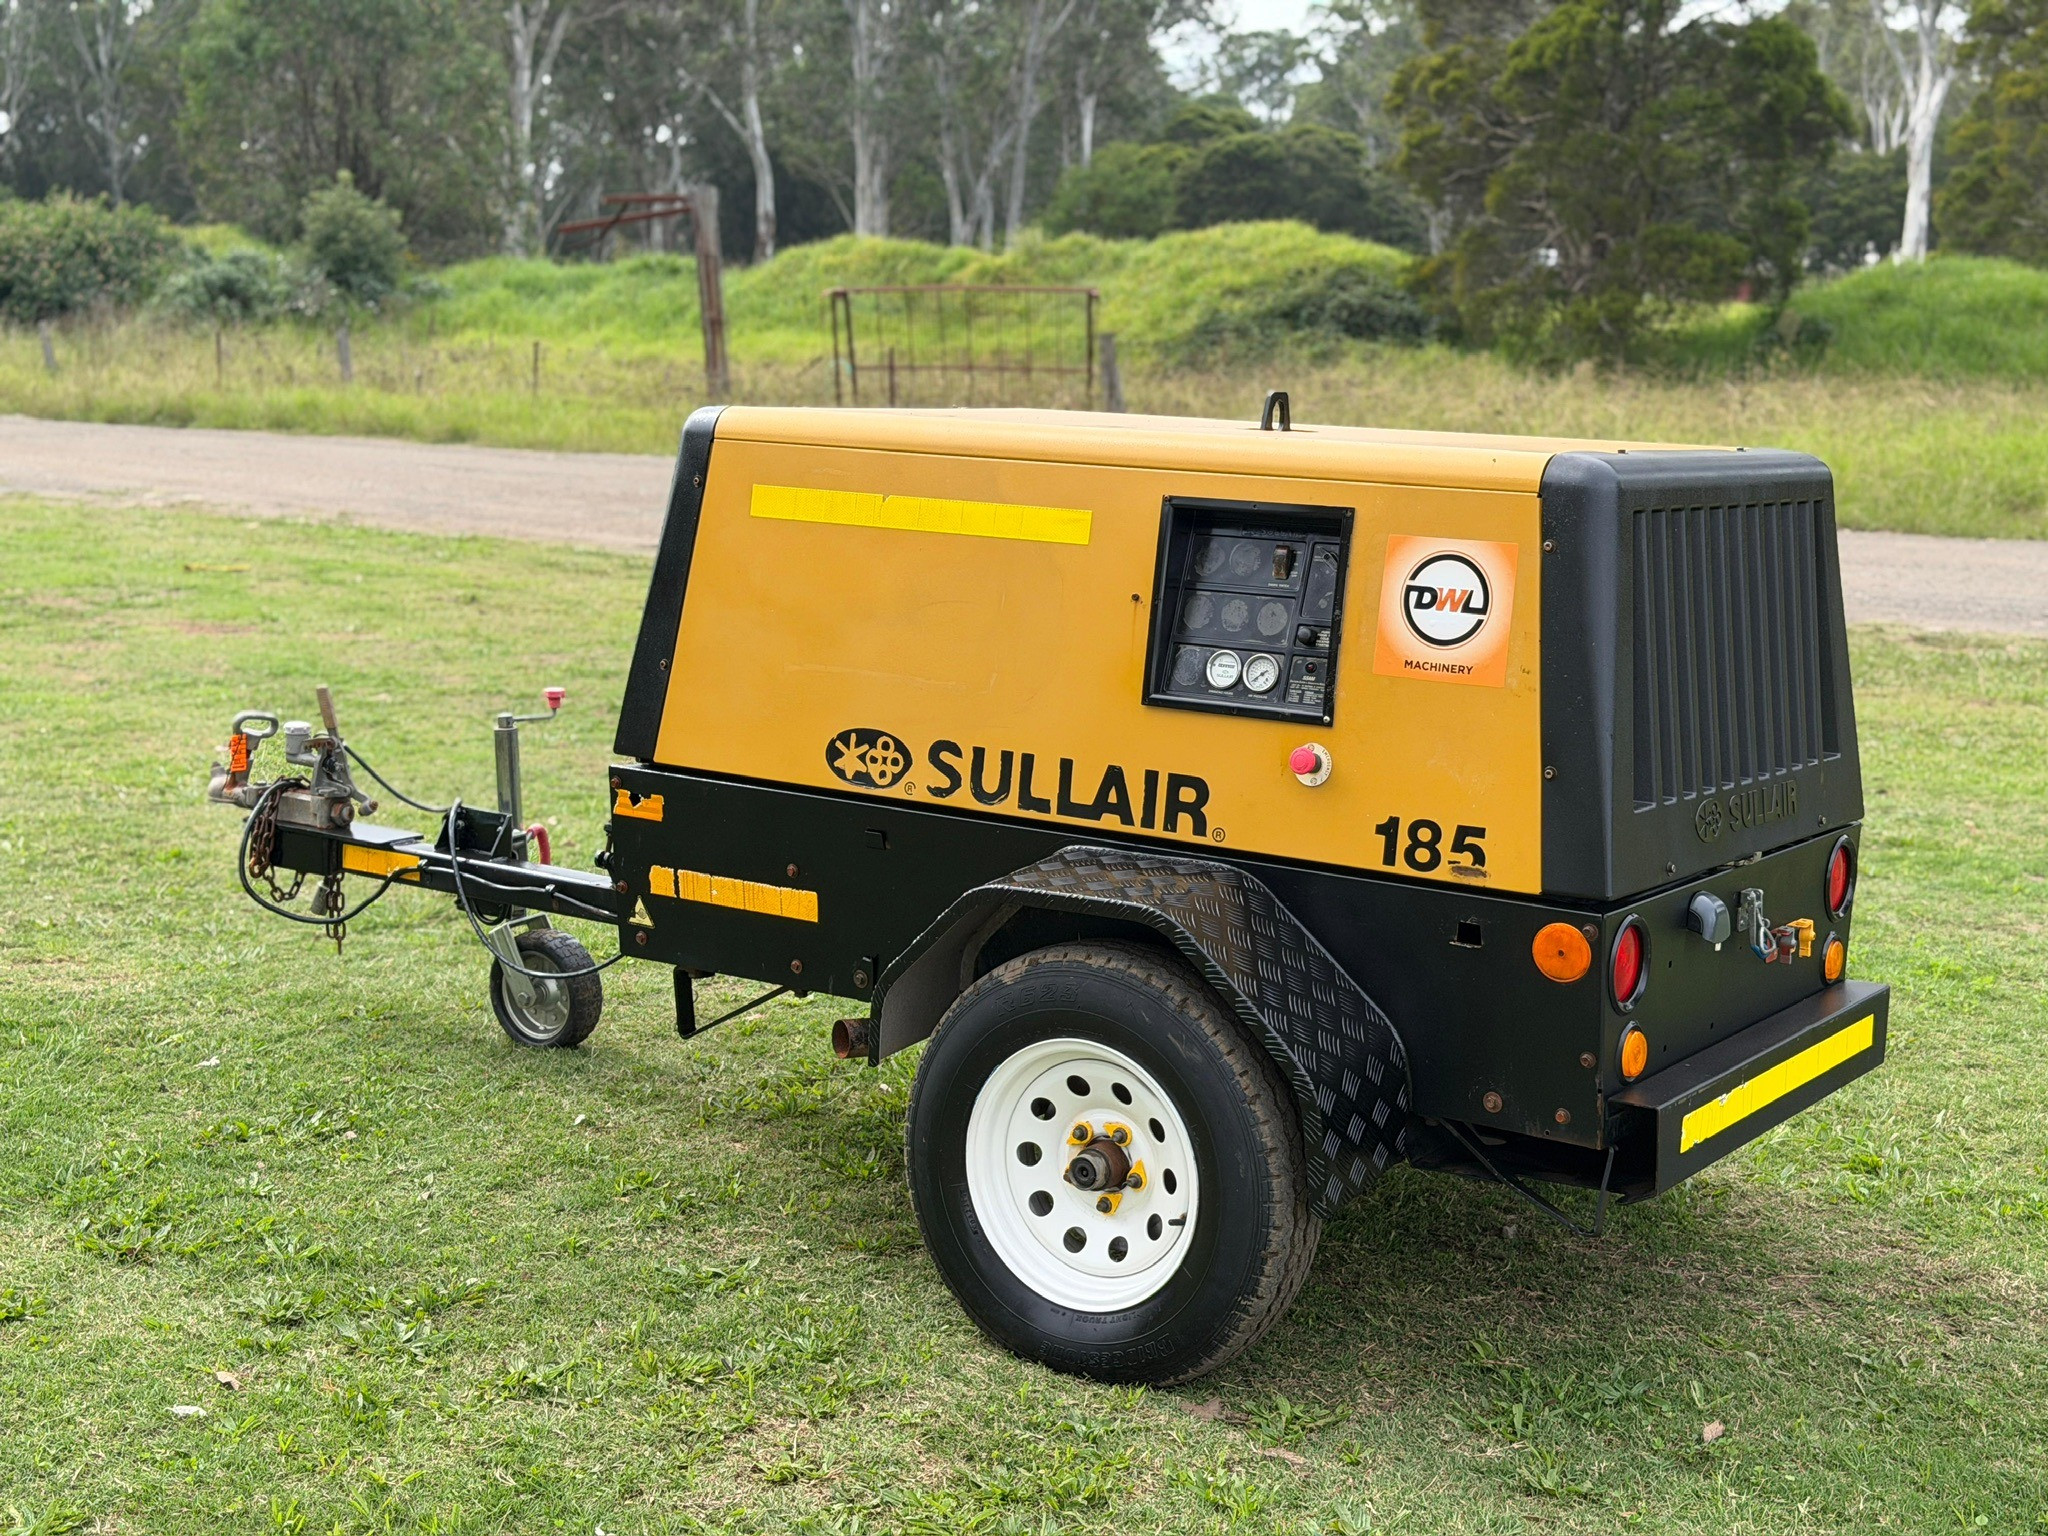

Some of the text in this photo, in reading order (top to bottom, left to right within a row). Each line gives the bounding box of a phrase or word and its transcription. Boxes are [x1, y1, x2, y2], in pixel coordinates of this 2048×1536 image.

[1405, 584, 1488, 615] DWL
[1404, 659, 1474, 675] MACHINERY
[926, 739, 1209, 838] SULLAIR
[1729, 780, 1797, 832] SULLAIR
[1374, 815, 1488, 878] 185
